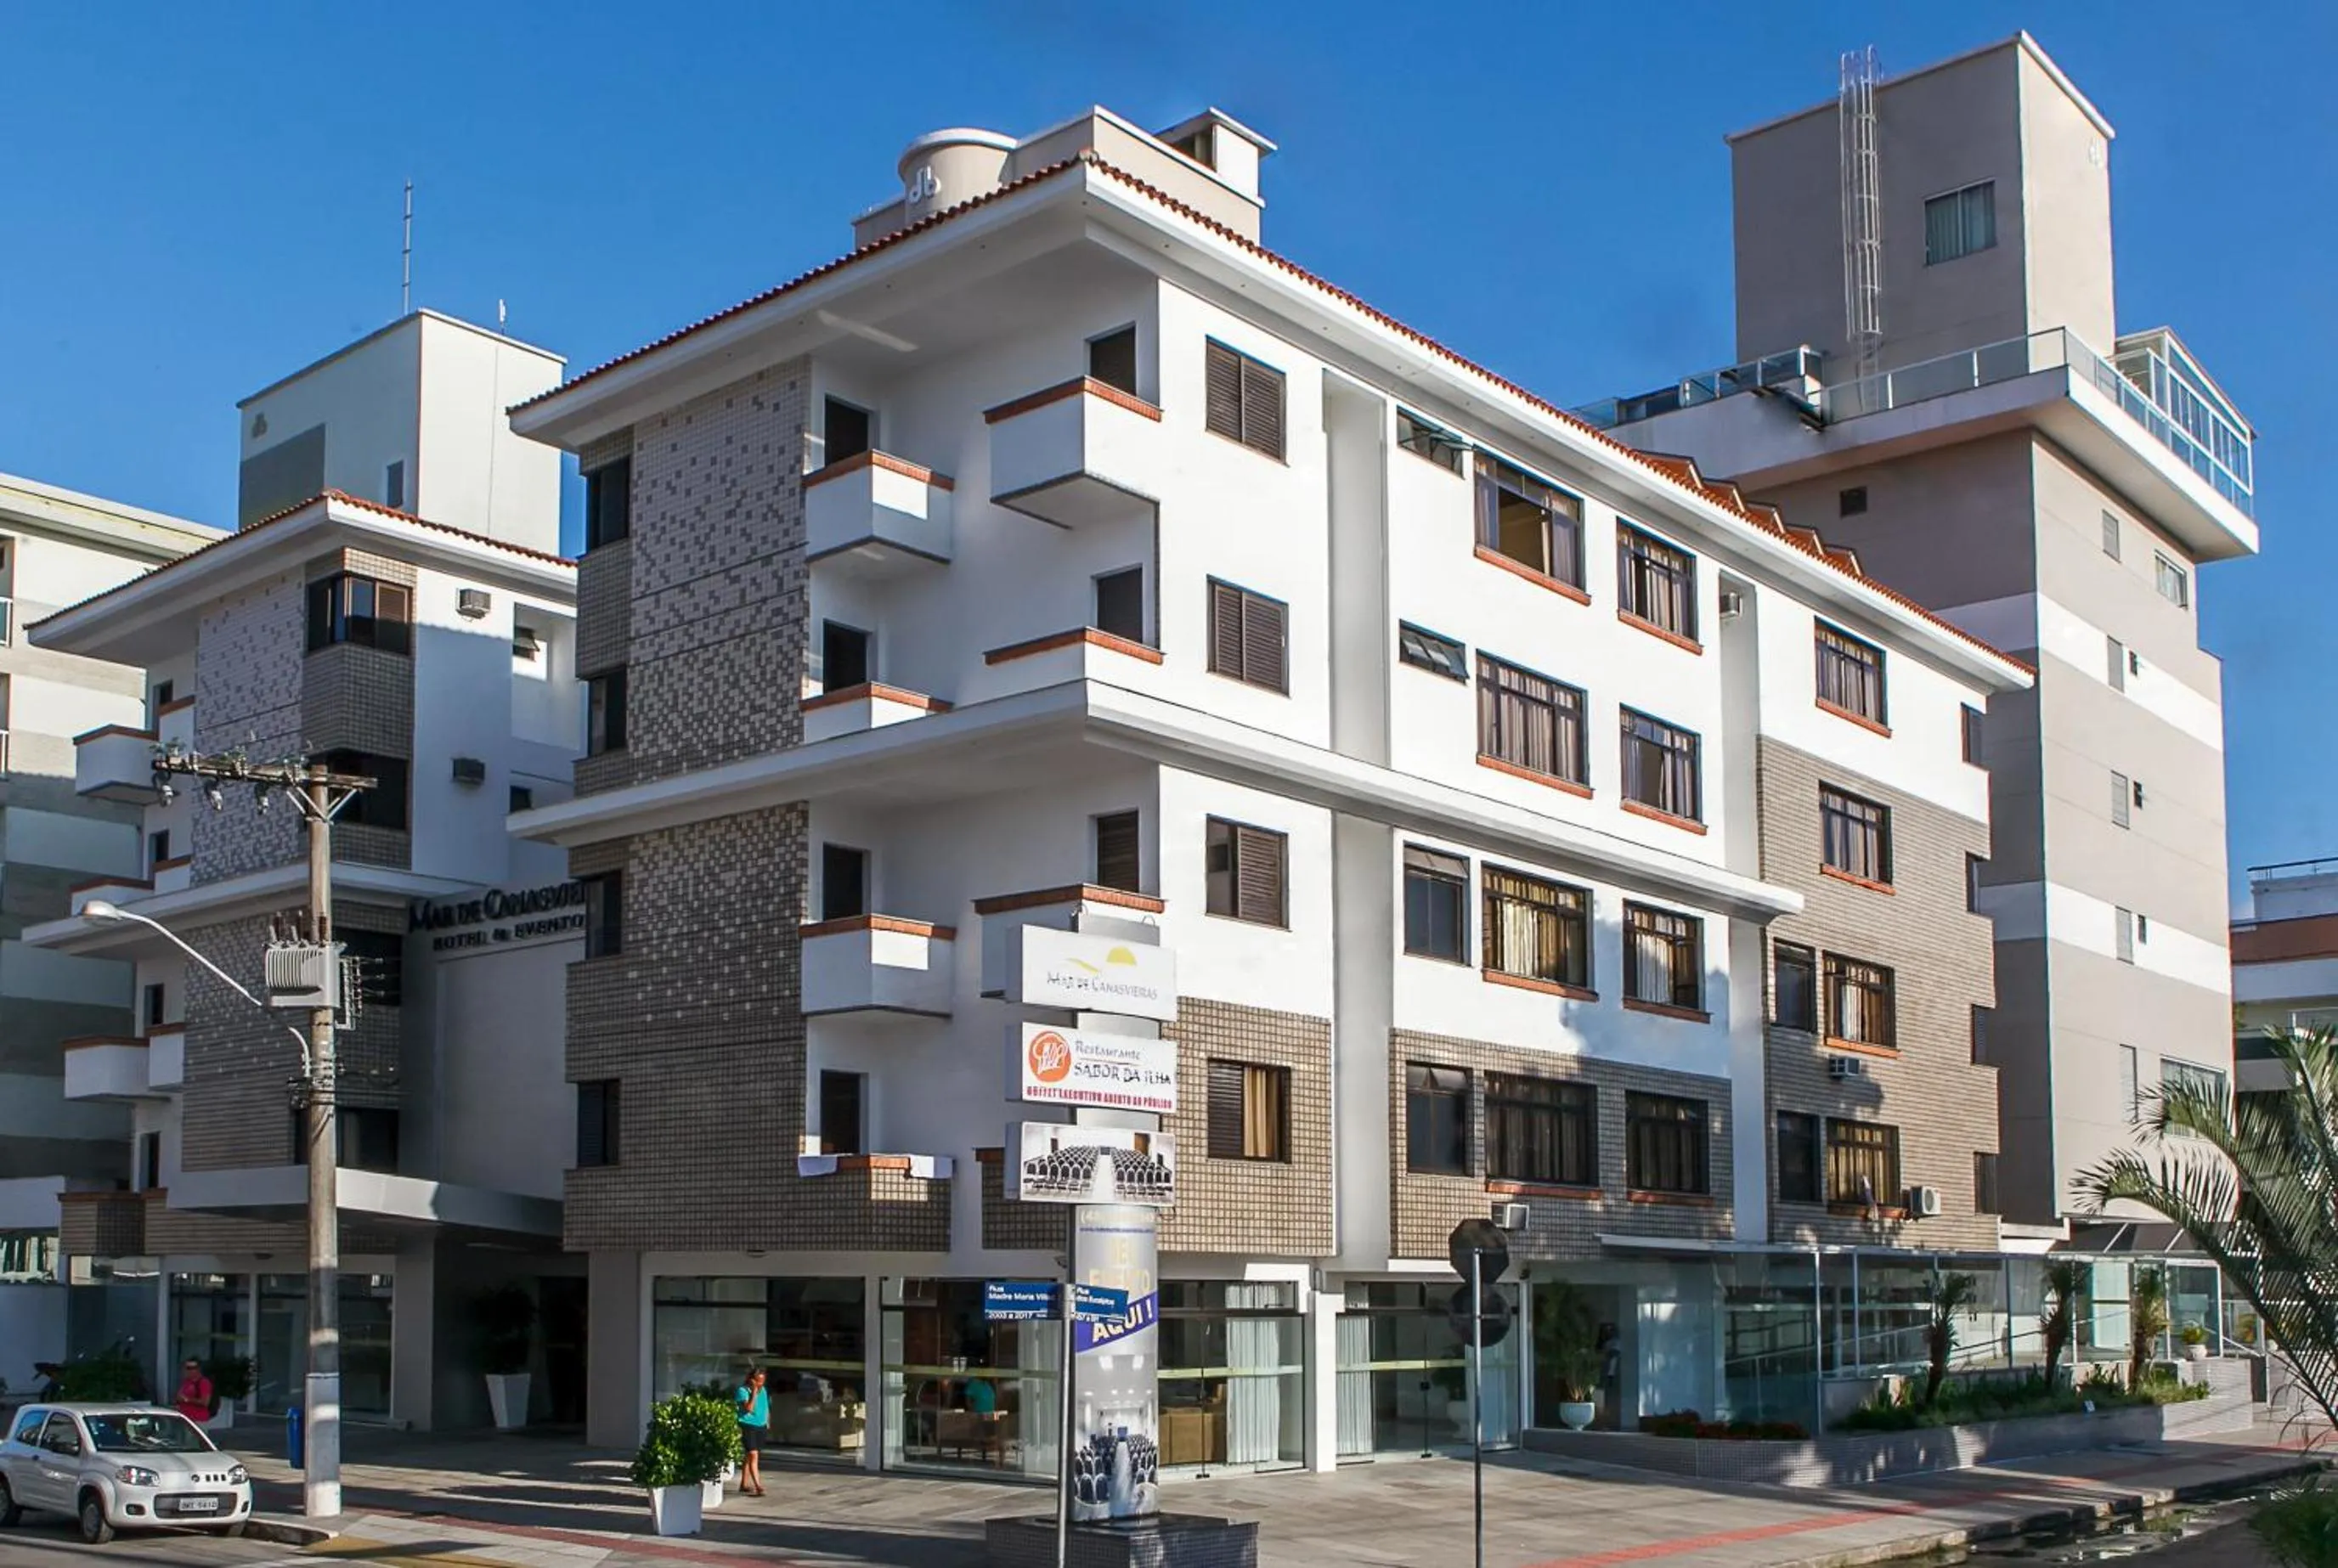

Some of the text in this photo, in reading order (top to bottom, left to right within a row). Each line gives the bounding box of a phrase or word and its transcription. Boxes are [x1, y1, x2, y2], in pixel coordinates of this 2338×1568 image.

[409, 900, 454, 933] MAR
[456, 900, 483, 924] DE
[1092, 975, 1158, 1001] CANASVIEIRAS
[1074, 1063, 1120, 1080] SABOR
[1123, 1067, 1140, 1082] DA
